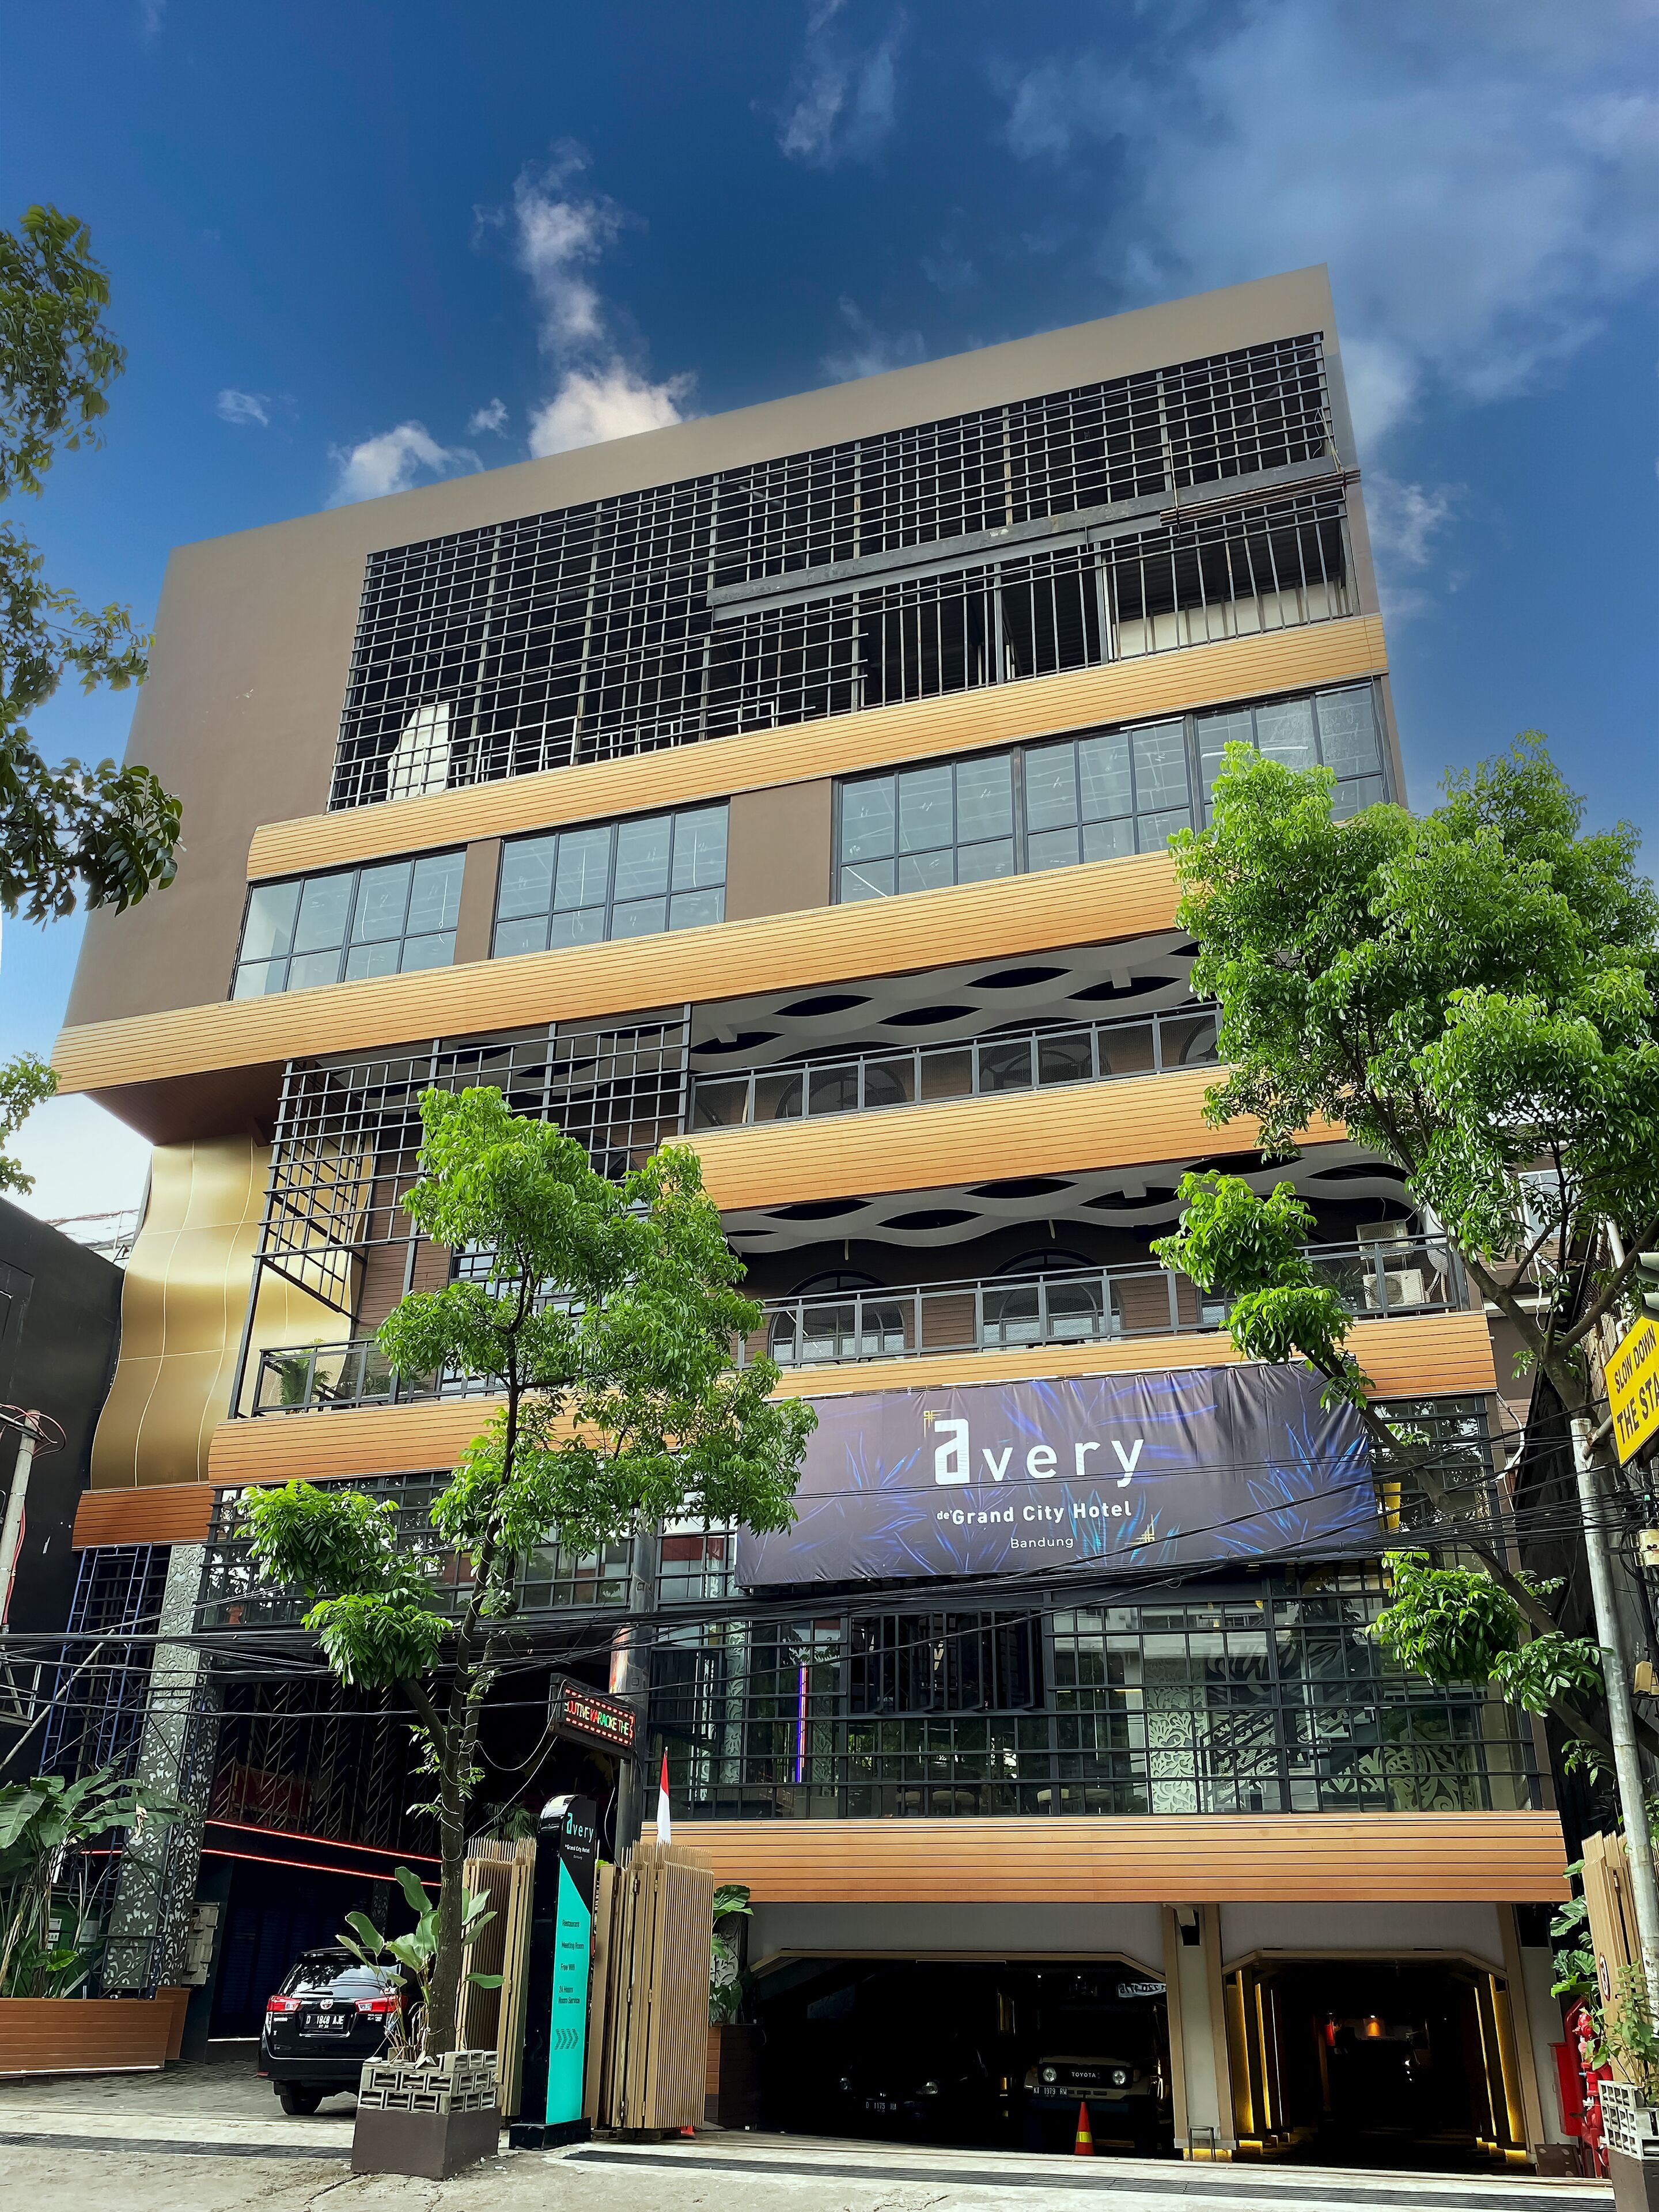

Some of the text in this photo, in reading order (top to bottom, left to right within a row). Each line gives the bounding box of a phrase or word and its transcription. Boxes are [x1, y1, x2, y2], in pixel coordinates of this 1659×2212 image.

[1614, 1324, 1657, 1394] SLOW DOWN
[1616, 1396, 1640, 1445] THE
[934, 1418, 1144, 1488] avery
[1022, 1505, 1065, 1524] City
[1073, 1501, 1132, 1519] Hotel
[1010, 1536, 1074, 1549] Bandung
[566, 1812, 594, 1843] avery
[561, 1941, 575, 1950] Meeting
[306, 2015, 311, 2024] D
[1044, 2087, 1056, 2095] 1979
